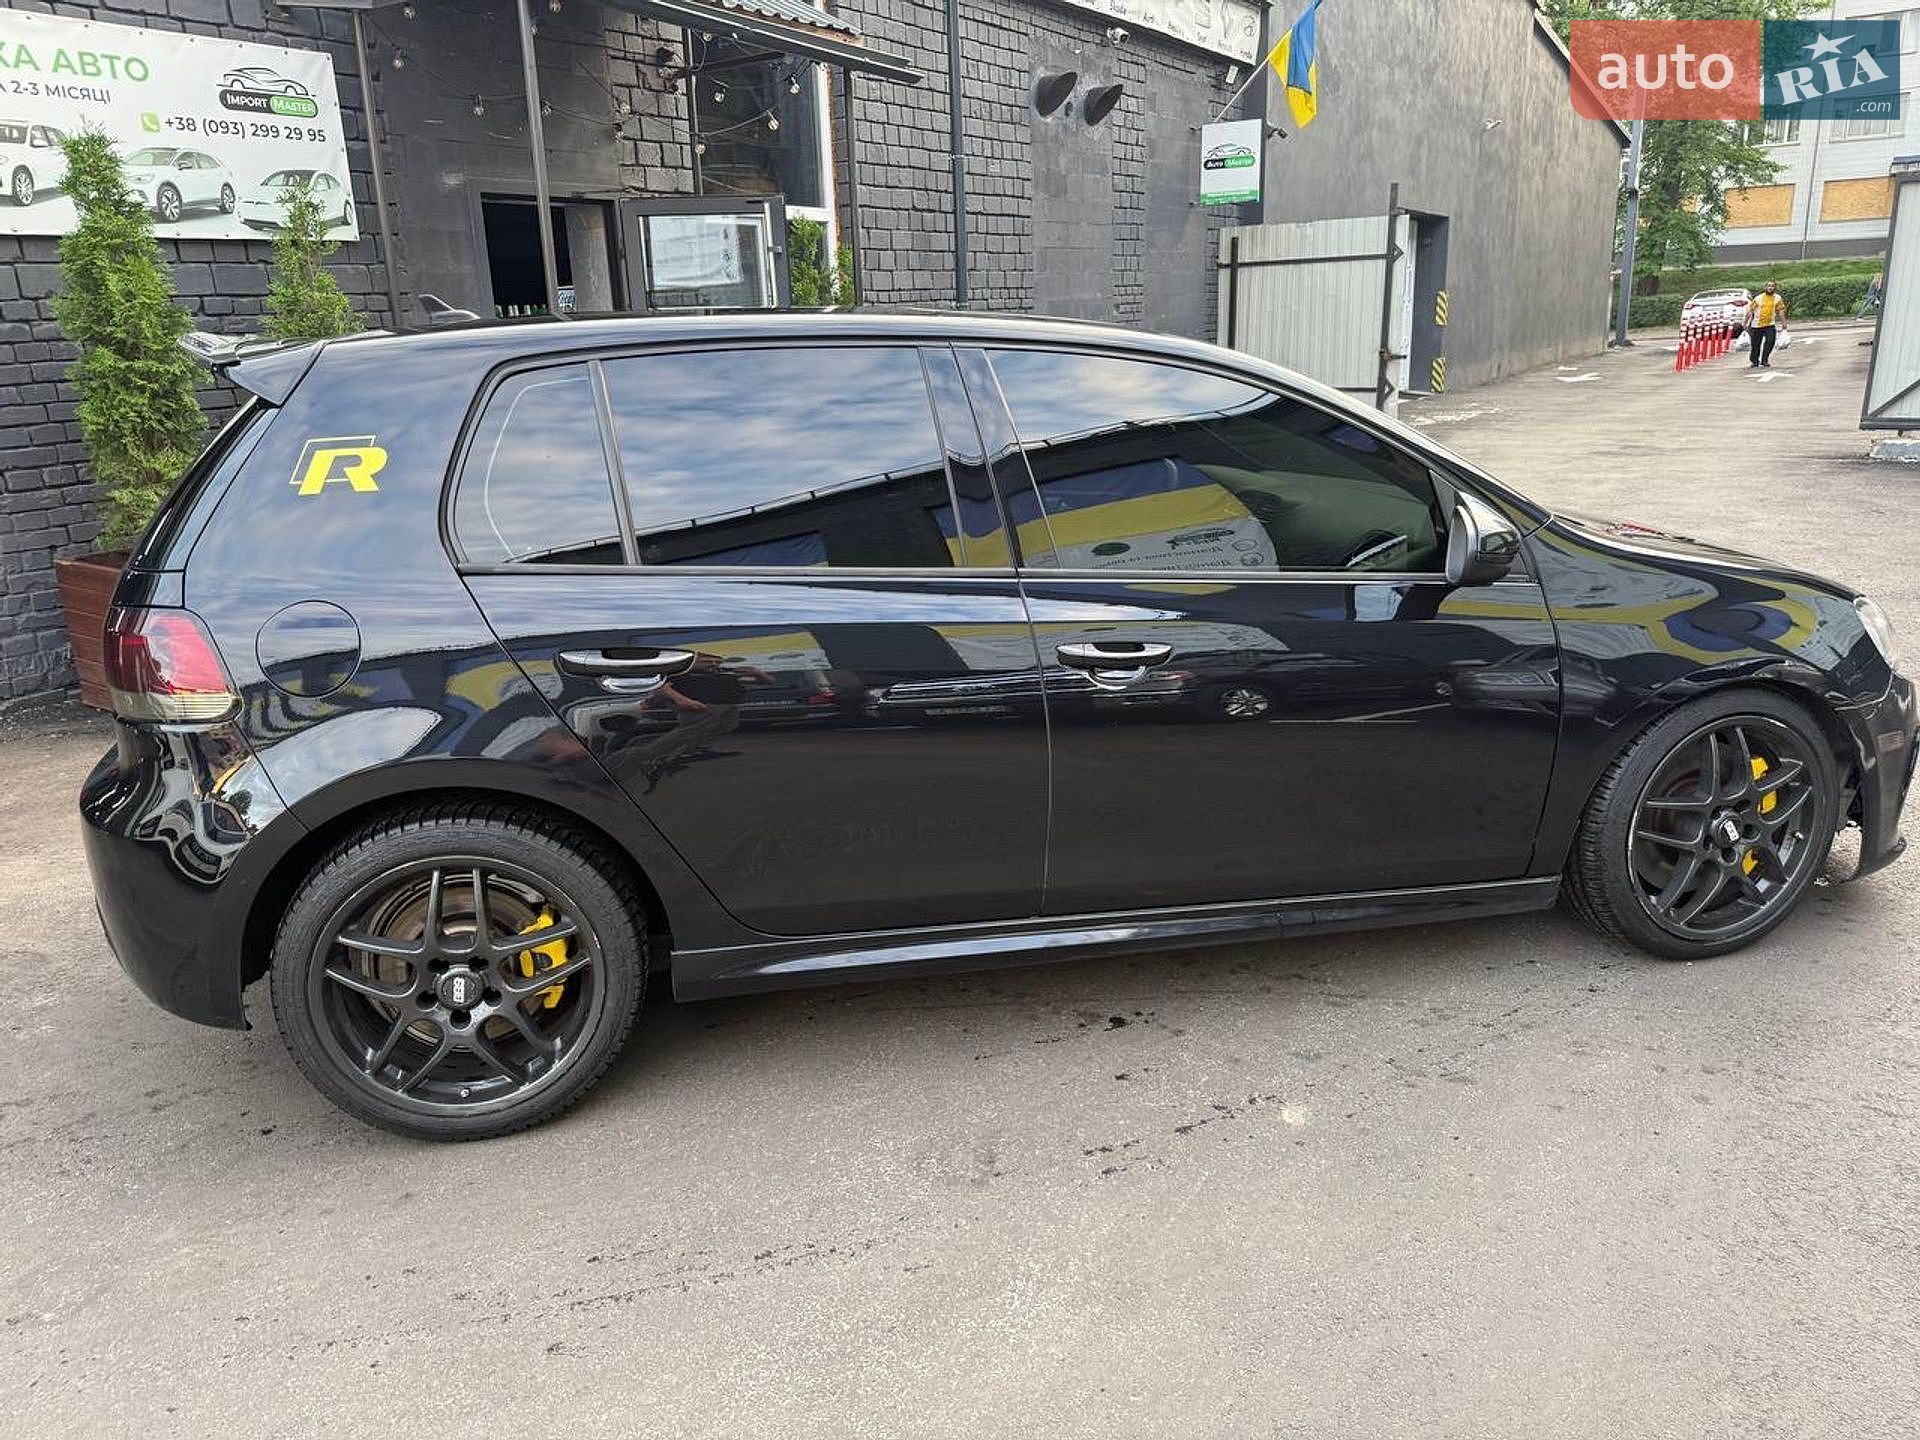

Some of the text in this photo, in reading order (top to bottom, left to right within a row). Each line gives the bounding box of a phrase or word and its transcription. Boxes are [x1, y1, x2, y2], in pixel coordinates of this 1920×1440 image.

[52, 48, 149, 82] АВТО
[10, 80, 39, 96] 2-3
[45, 84, 111, 105] МІСЯЦІ
[226, 92, 316, 113] IMPORT MASTER
[165, 117, 327, 143] +38 (093) 299 29 95
[298, 446, 388, 495] R
